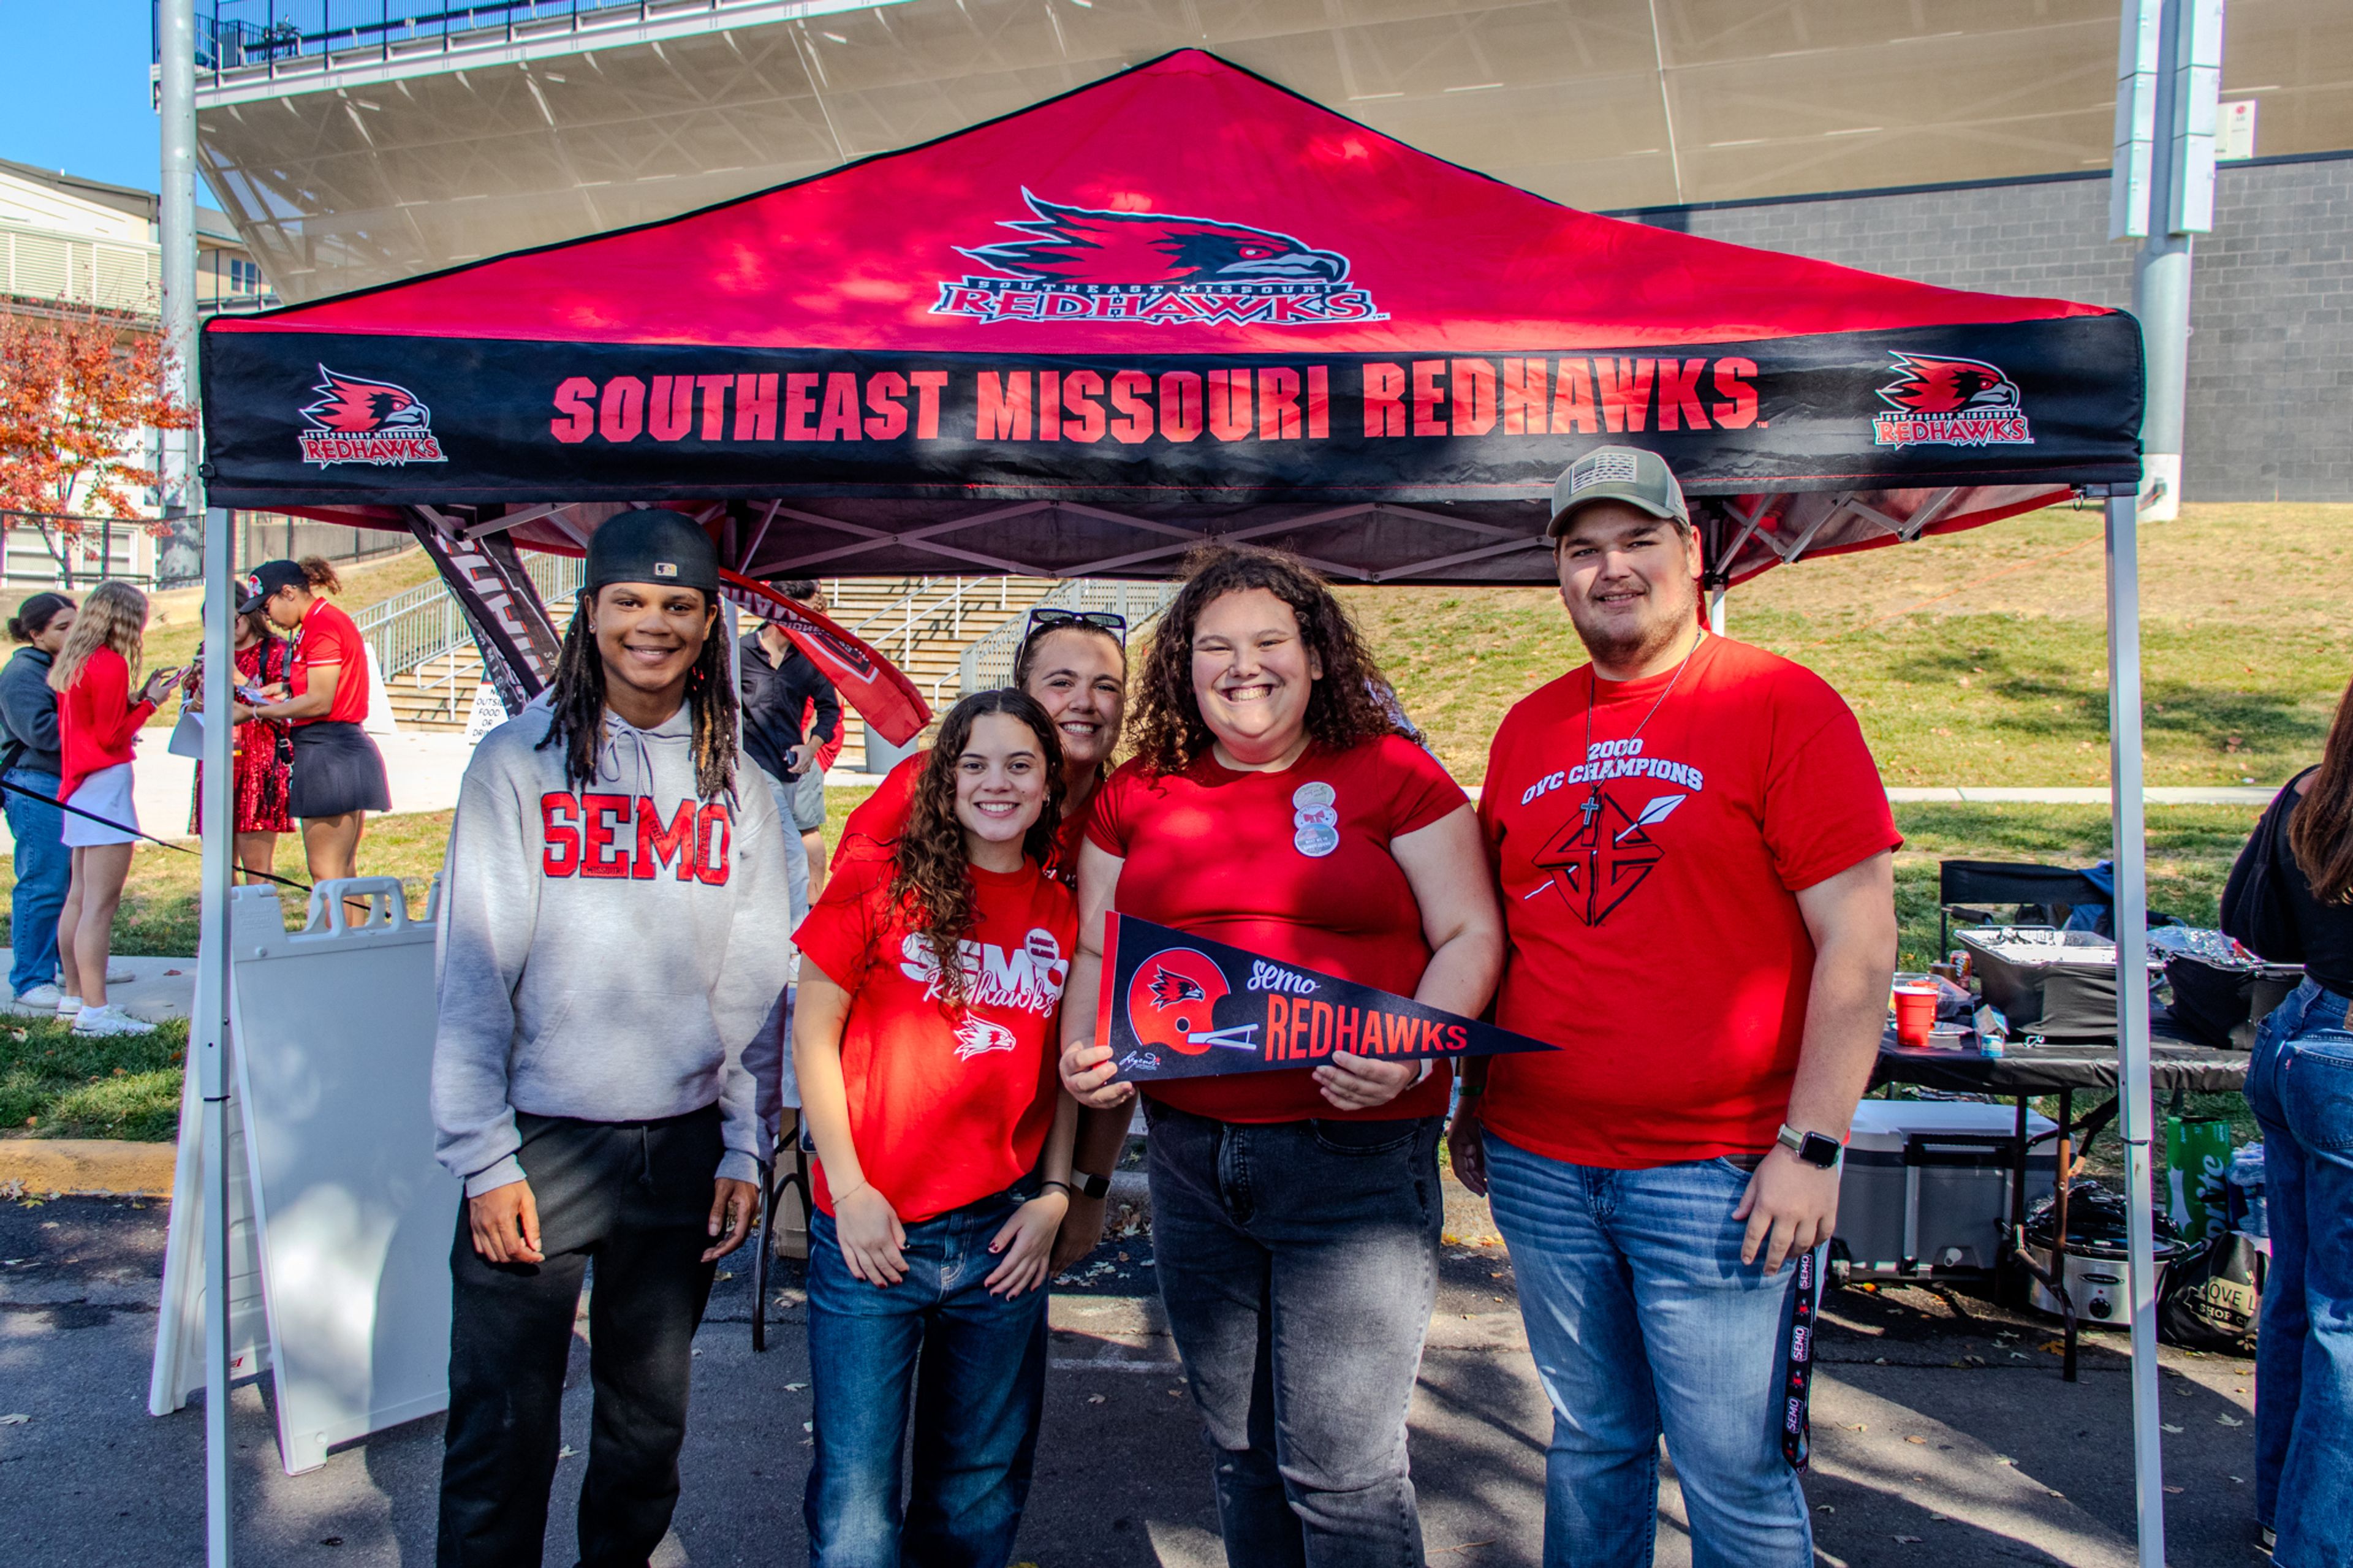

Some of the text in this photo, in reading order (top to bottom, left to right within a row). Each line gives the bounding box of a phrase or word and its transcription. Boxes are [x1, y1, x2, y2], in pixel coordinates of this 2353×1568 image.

[941, 286, 1370, 322] REDHAWKS
[979, 281, 1332, 295] SOUTHEAST MISSOURI
[551, 371, 949, 443] SOUTHEAST
[976, 365, 1330, 444] MISSOURI
[1363, 357, 1758, 437] REDHAWKS
[1877, 419, 2027, 443] REDHAWKS
[303, 438, 442, 461] REDHAWKS
[479, 708, 501, 717] FOOD
[1588, 738, 1643, 760] 2000
[1521, 757, 1704, 806] OVC CHAMPIONS
[540, 791, 732, 887] SEMO
[1246, 959, 1320, 994] semo
[1265, 994, 1468, 1061] REDHAWKS
[2196, 1154, 2229, 1251] prite
[1800, 1255, 1809, 1289] SEMO
[2199, 1303, 2232, 1320] SHOP
[1793, 1327, 1805, 1360] SEMO
[1787, 1398, 1799, 1431] SEMO
